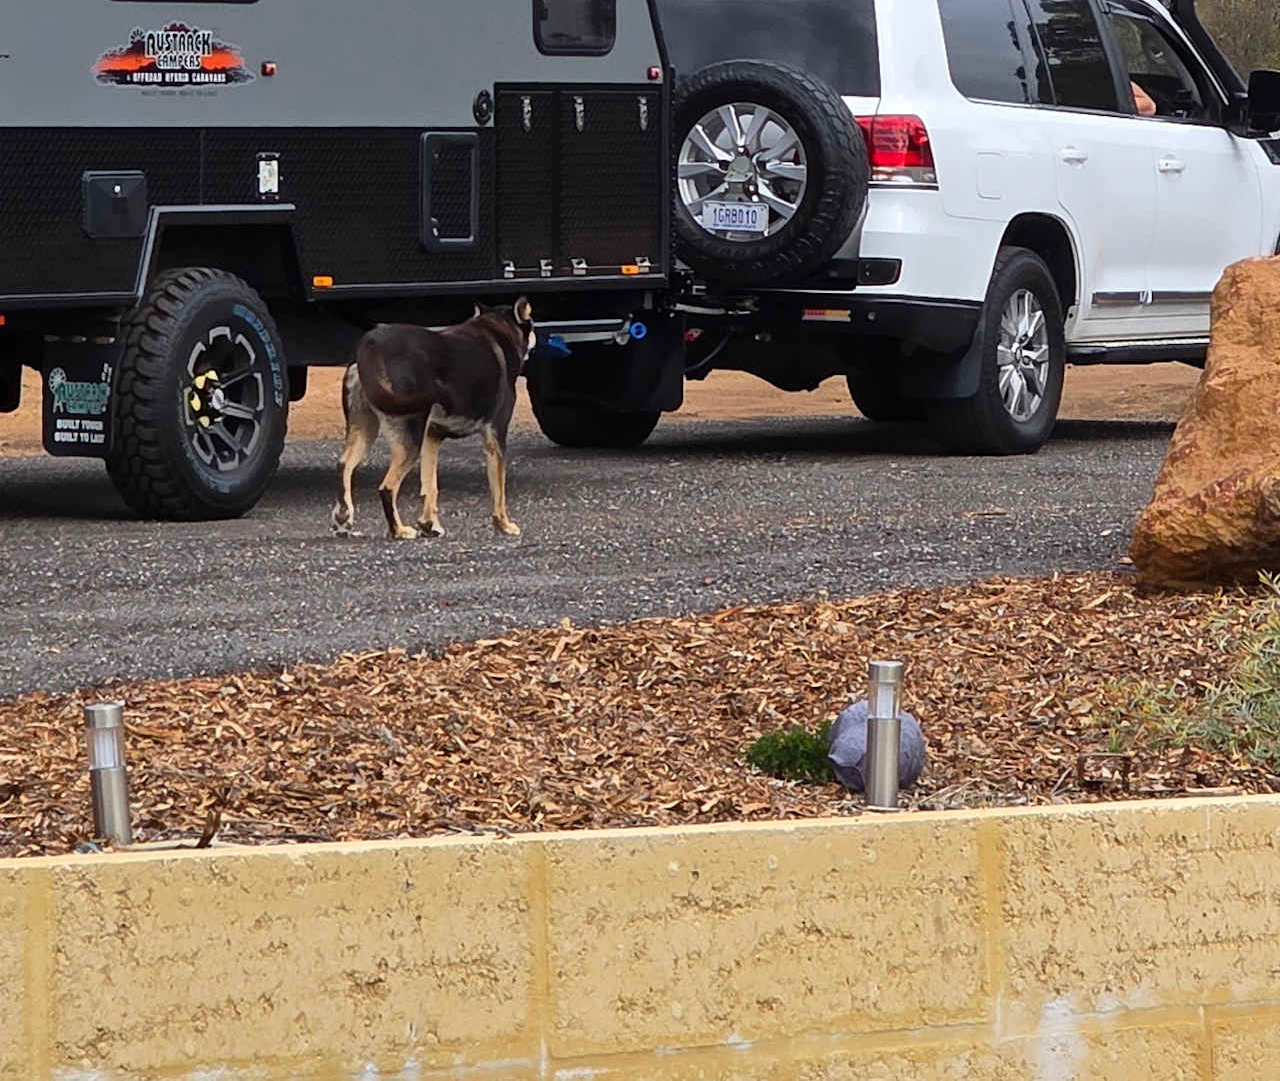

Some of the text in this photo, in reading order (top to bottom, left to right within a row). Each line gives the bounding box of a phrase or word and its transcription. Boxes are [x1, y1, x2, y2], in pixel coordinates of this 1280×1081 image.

[145, 31, 212, 57] AUSTRACK
[155, 54, 202, 69] CAMPERS
[132, 72, 163, 82] OFFROAD
[165, 73, 189, 82] HYBRID
[191, 73, 226, 82] CARAVANS
